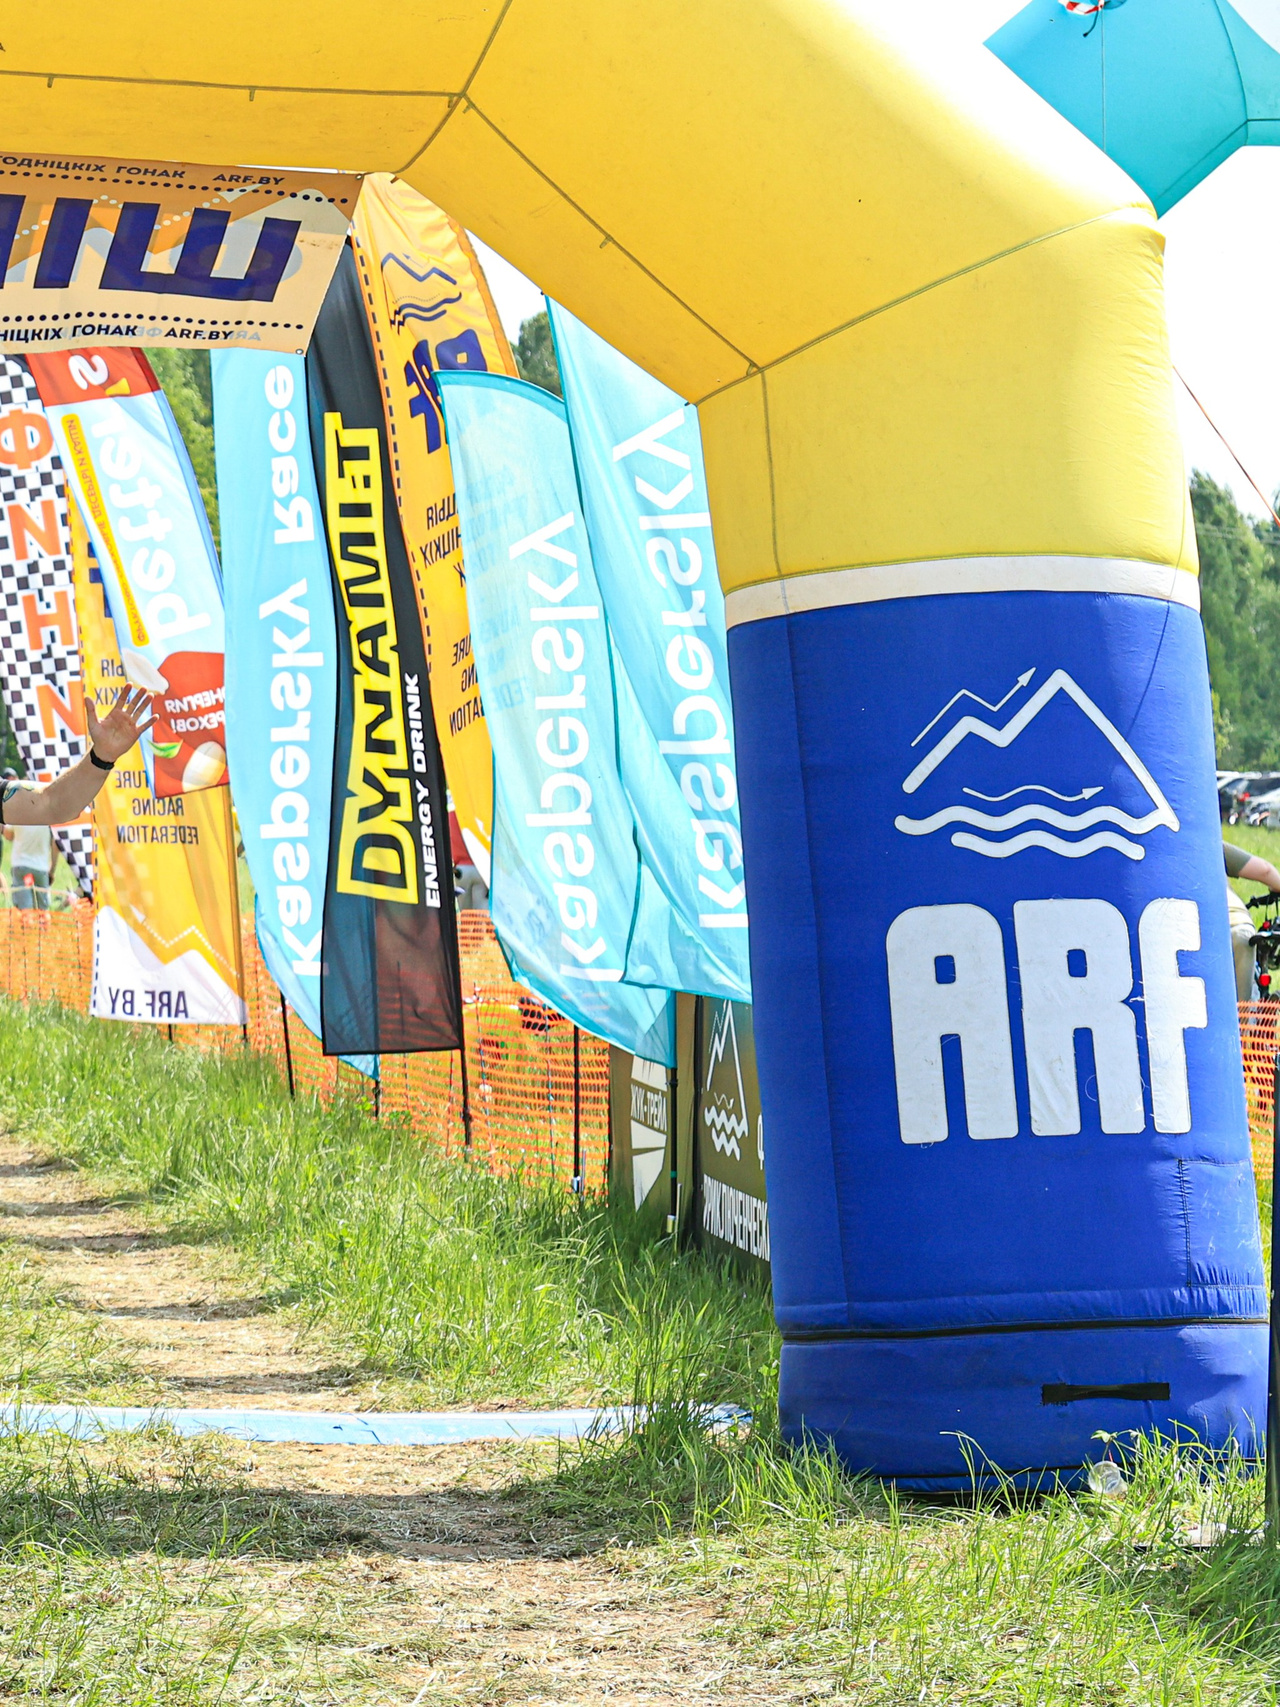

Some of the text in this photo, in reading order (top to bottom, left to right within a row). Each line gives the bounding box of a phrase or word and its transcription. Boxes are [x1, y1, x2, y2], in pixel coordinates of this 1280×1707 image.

[115, 165, 186, 179] ГОНАК
[212, 173, 285, 186] ARF.BY
[71, 323, 139, 338] ГОНАК
[163, 327, 236, 341] ARF.BY
[405, 672, 442, 908] ENERGY DRINK
[886, 898, 1208, 1145] ARF
